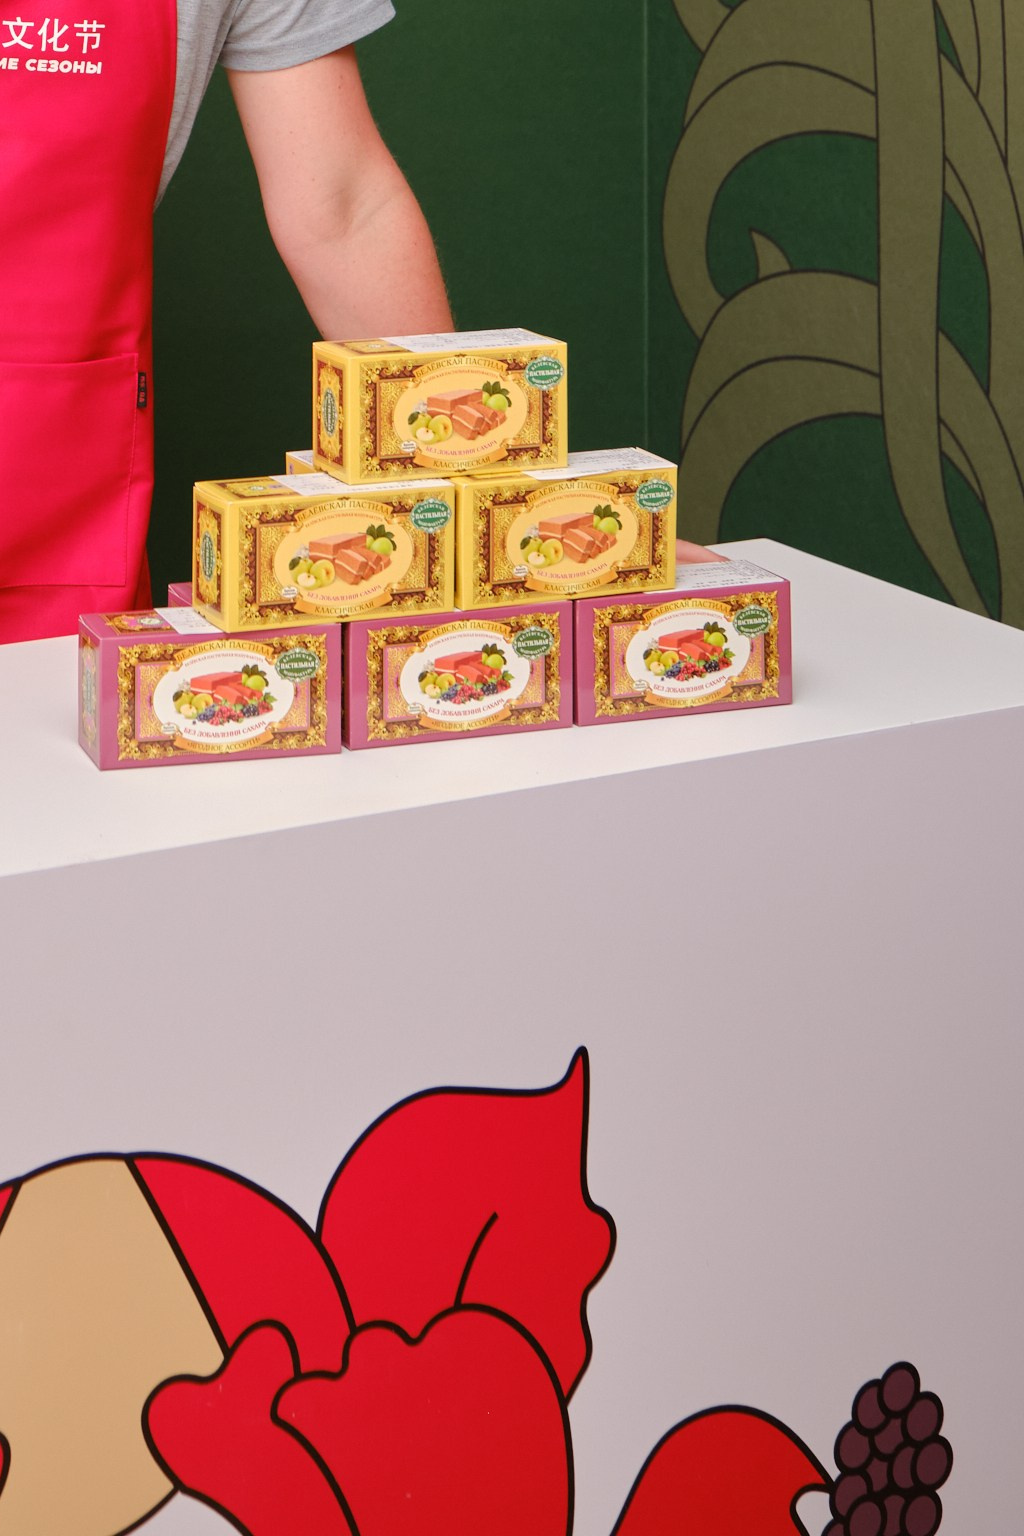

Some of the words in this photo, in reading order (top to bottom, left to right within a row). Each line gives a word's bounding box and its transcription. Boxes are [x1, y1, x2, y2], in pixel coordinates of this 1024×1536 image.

[25, 58, 103, 75] СЕЗОНЫ
[465, 357, 505, 372] ПАСТИЛА
[576, 480, 615, 495] ПАСТИЛА
[348, 499, 390, 515] ПАСТИЛА
[691, 599, 730, 614] ПАСТИЛА
[470, 621, 508, 636] ПАСТИЛА
[229, 640, 270, 656] ПАСТИЛА
